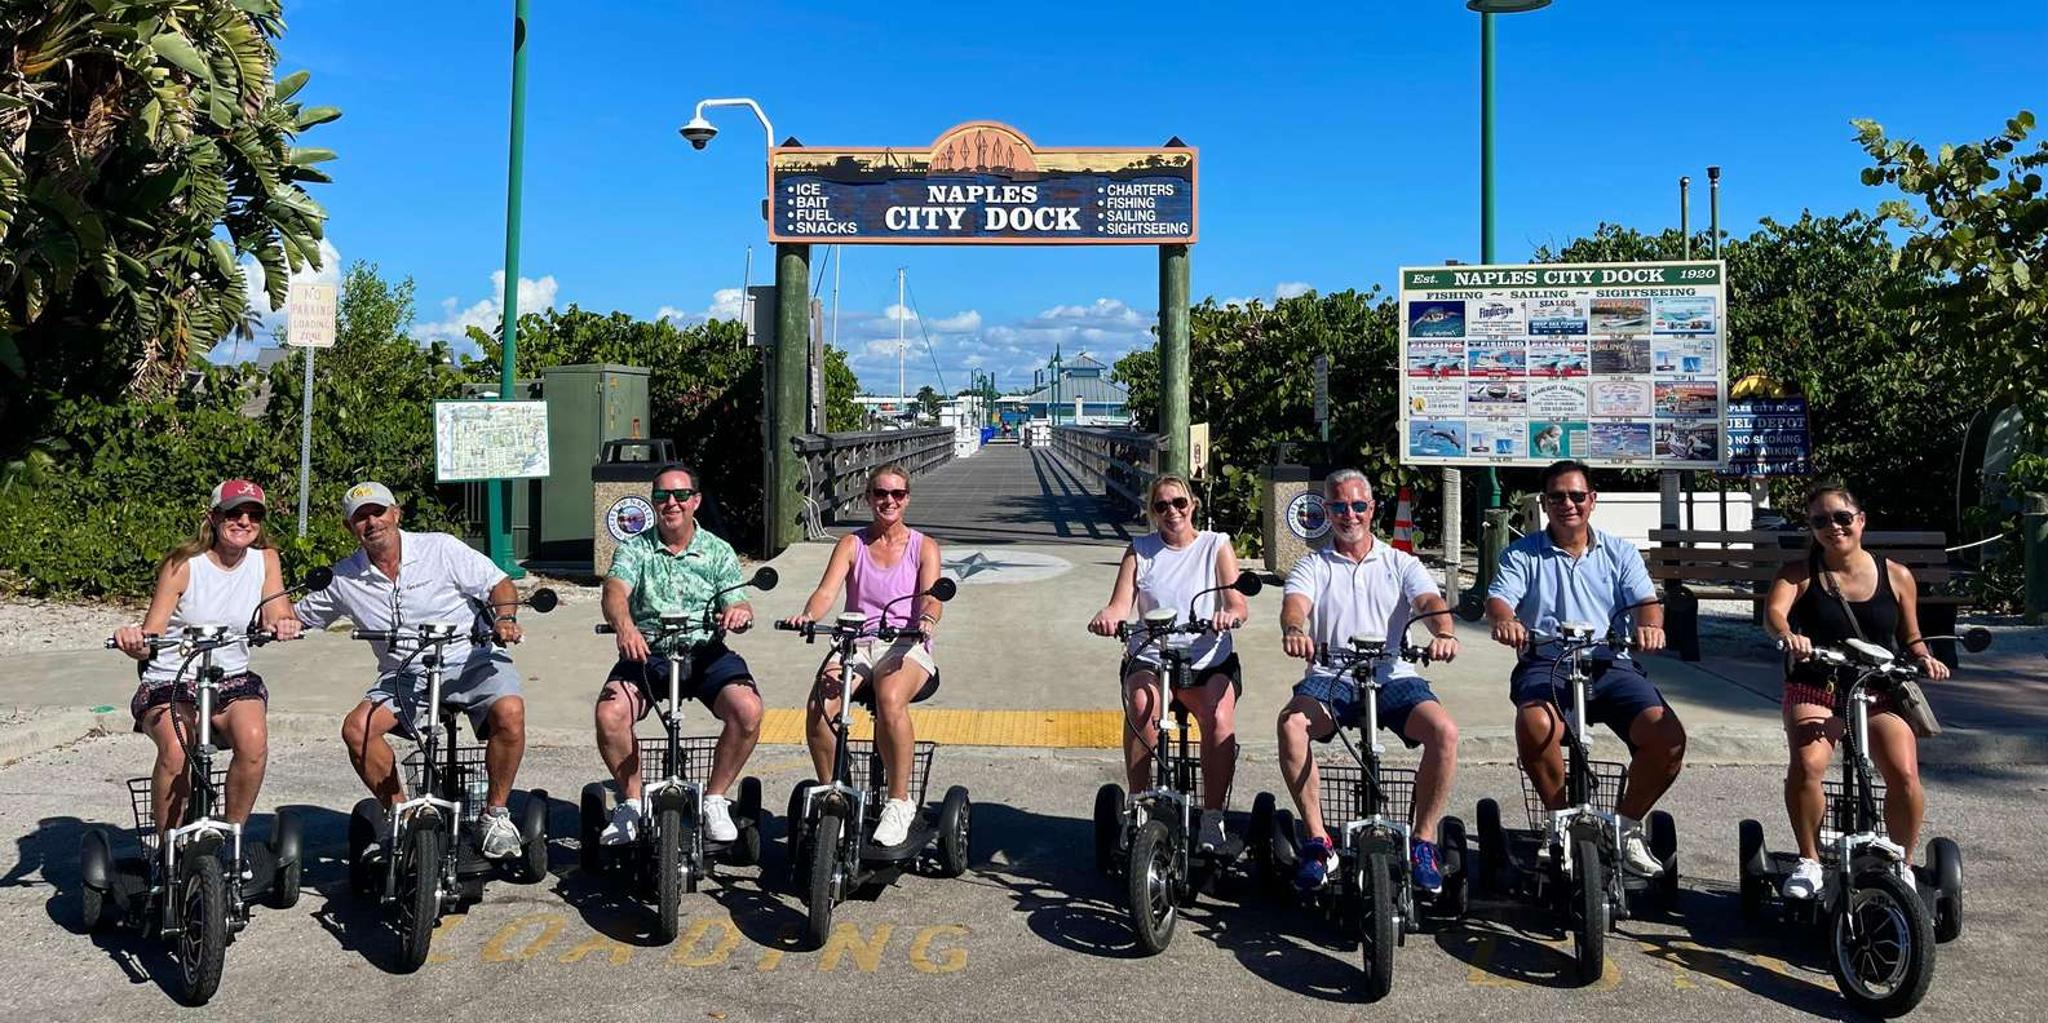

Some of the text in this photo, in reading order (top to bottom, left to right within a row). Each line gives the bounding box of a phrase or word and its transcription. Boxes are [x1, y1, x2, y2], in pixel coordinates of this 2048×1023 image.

[796, 184, 821, 195] ICE
[927, 185, 1038, 203] NAPLES
[1106, 184, 1174, 196] CHARTERS
[796, 196, 830, 208] BAIT
[1106, 197, 1156, 209] FISHING
[796, 209, 835, 221] FUEL
[885, 206, 1081, 231] CITY DOCK
[1106, 210, 1156, 221] SAILING
[796, 221, 858, 234] SNACKS
[1106, 222, 1189, 235] SIGHTSEEING
[1412, 268, 1716, 286] Est. NAPLES CITY DOCK 1920
[304, 289, 320, 300] NO
[1426, 288, 1696, 300] FISHING SAILING SIGHTSEEING
[292, 303, 332, 316] PARKING
[293, 319, 332, 329] LOADING
[1757, 417, 1806, 428] DEPOT
[1735, 434, 1801, 445] NO SMOKING
[1736, 446, 1800, 456] NO PARKING
[1746, 463, 1771, 474] 12TH
[1774, 462, 1794, 473] AVE
